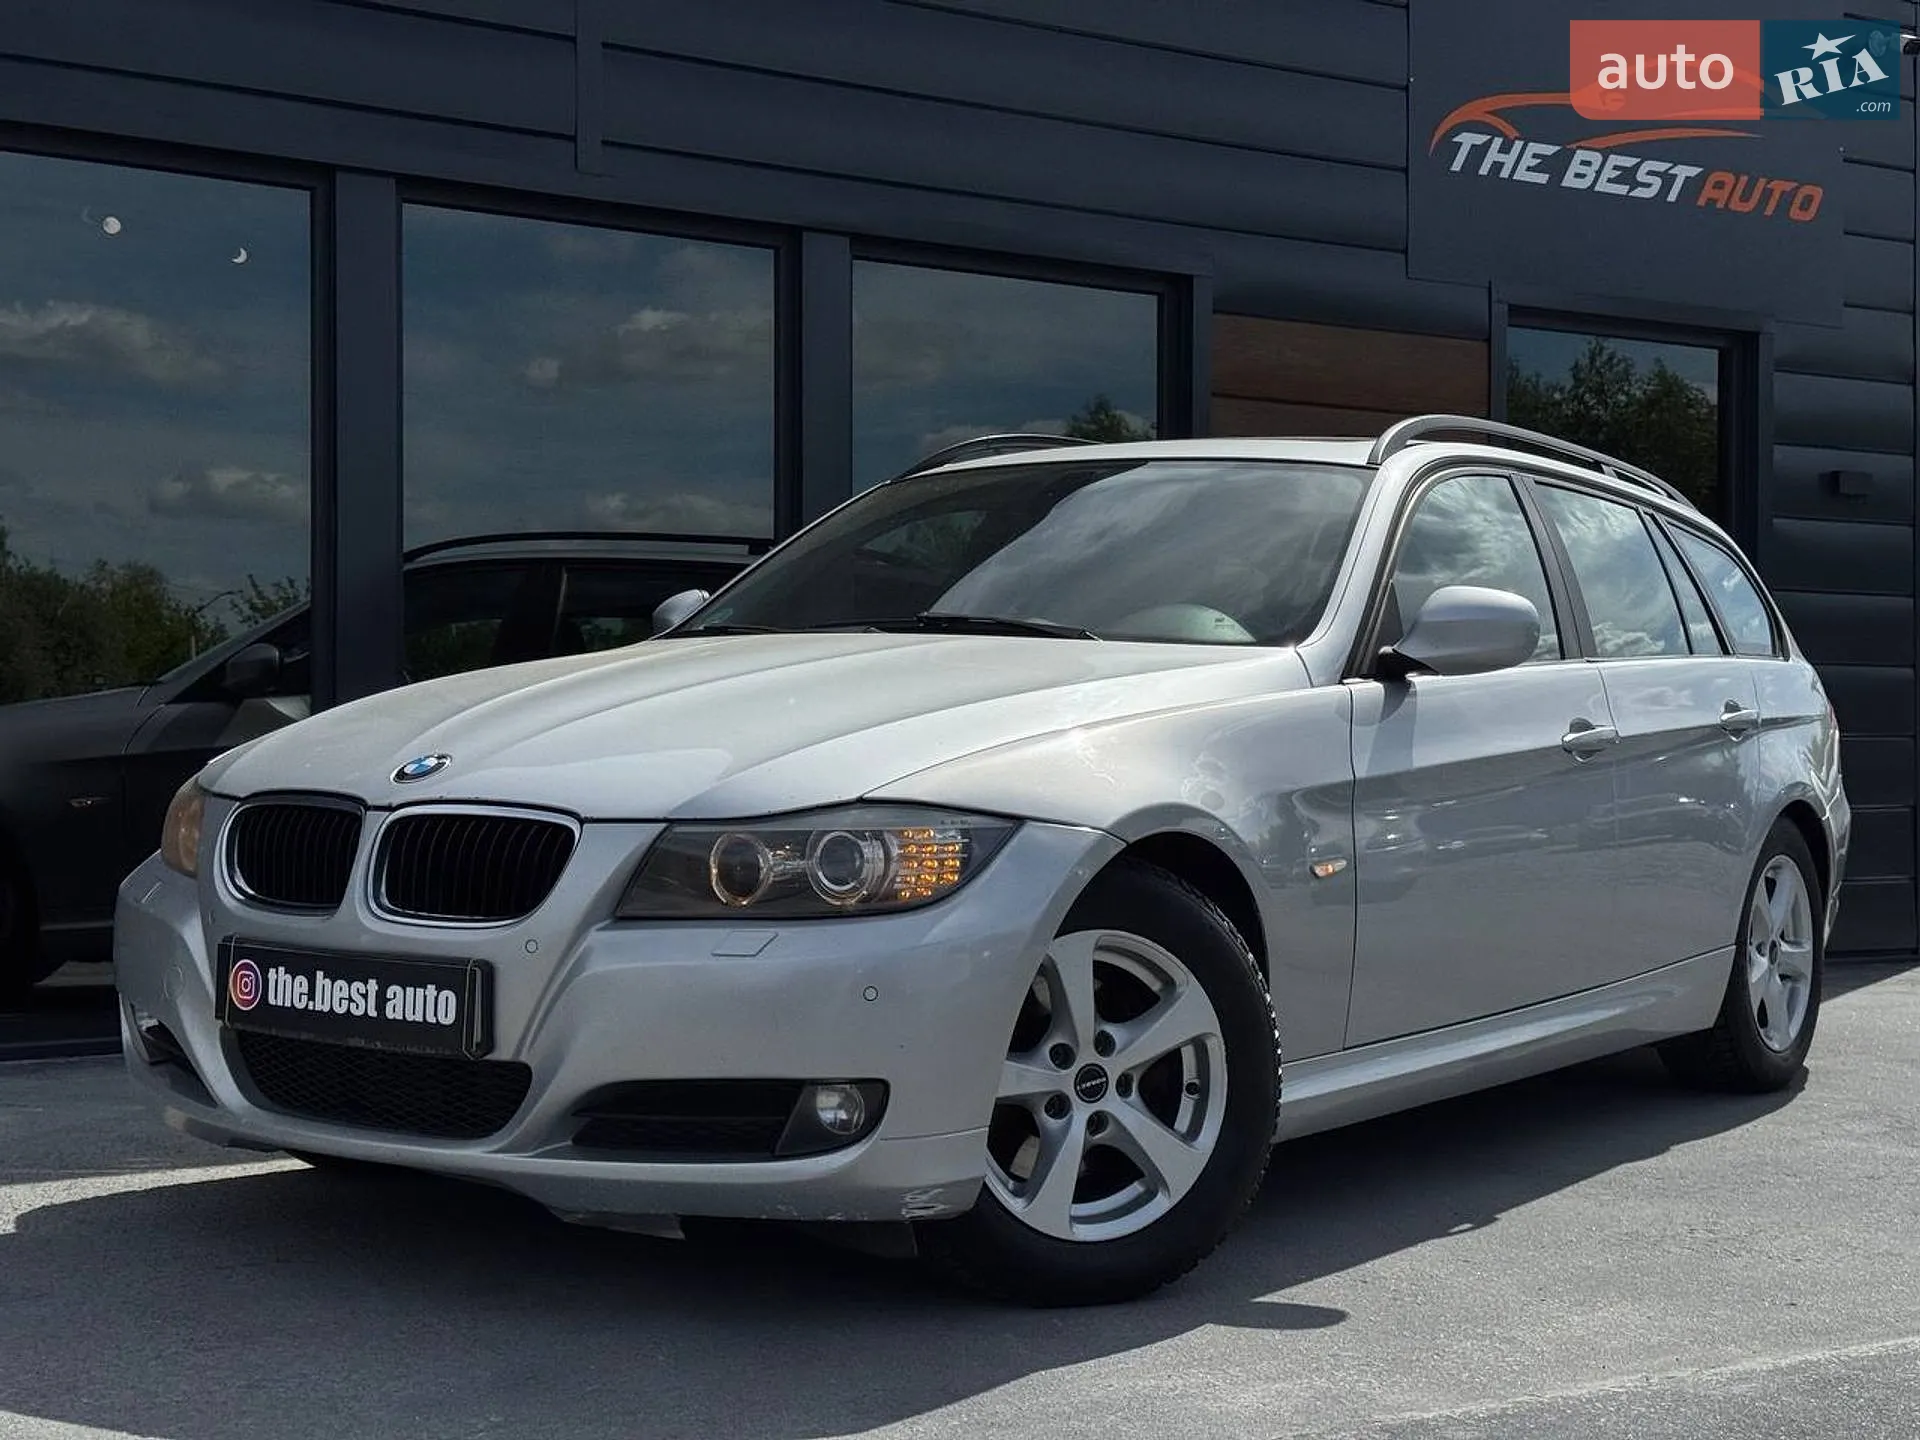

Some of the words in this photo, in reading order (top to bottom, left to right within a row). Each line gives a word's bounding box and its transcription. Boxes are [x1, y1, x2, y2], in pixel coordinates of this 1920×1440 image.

[1450, 132, 1563, 184] THE
[1561, 150, 1703, 202] BEST
[1697, 171, 1824, 221] AUTO
[268, 966, 378, 1017] the.best
[386, 985, 457, 1025] auto
